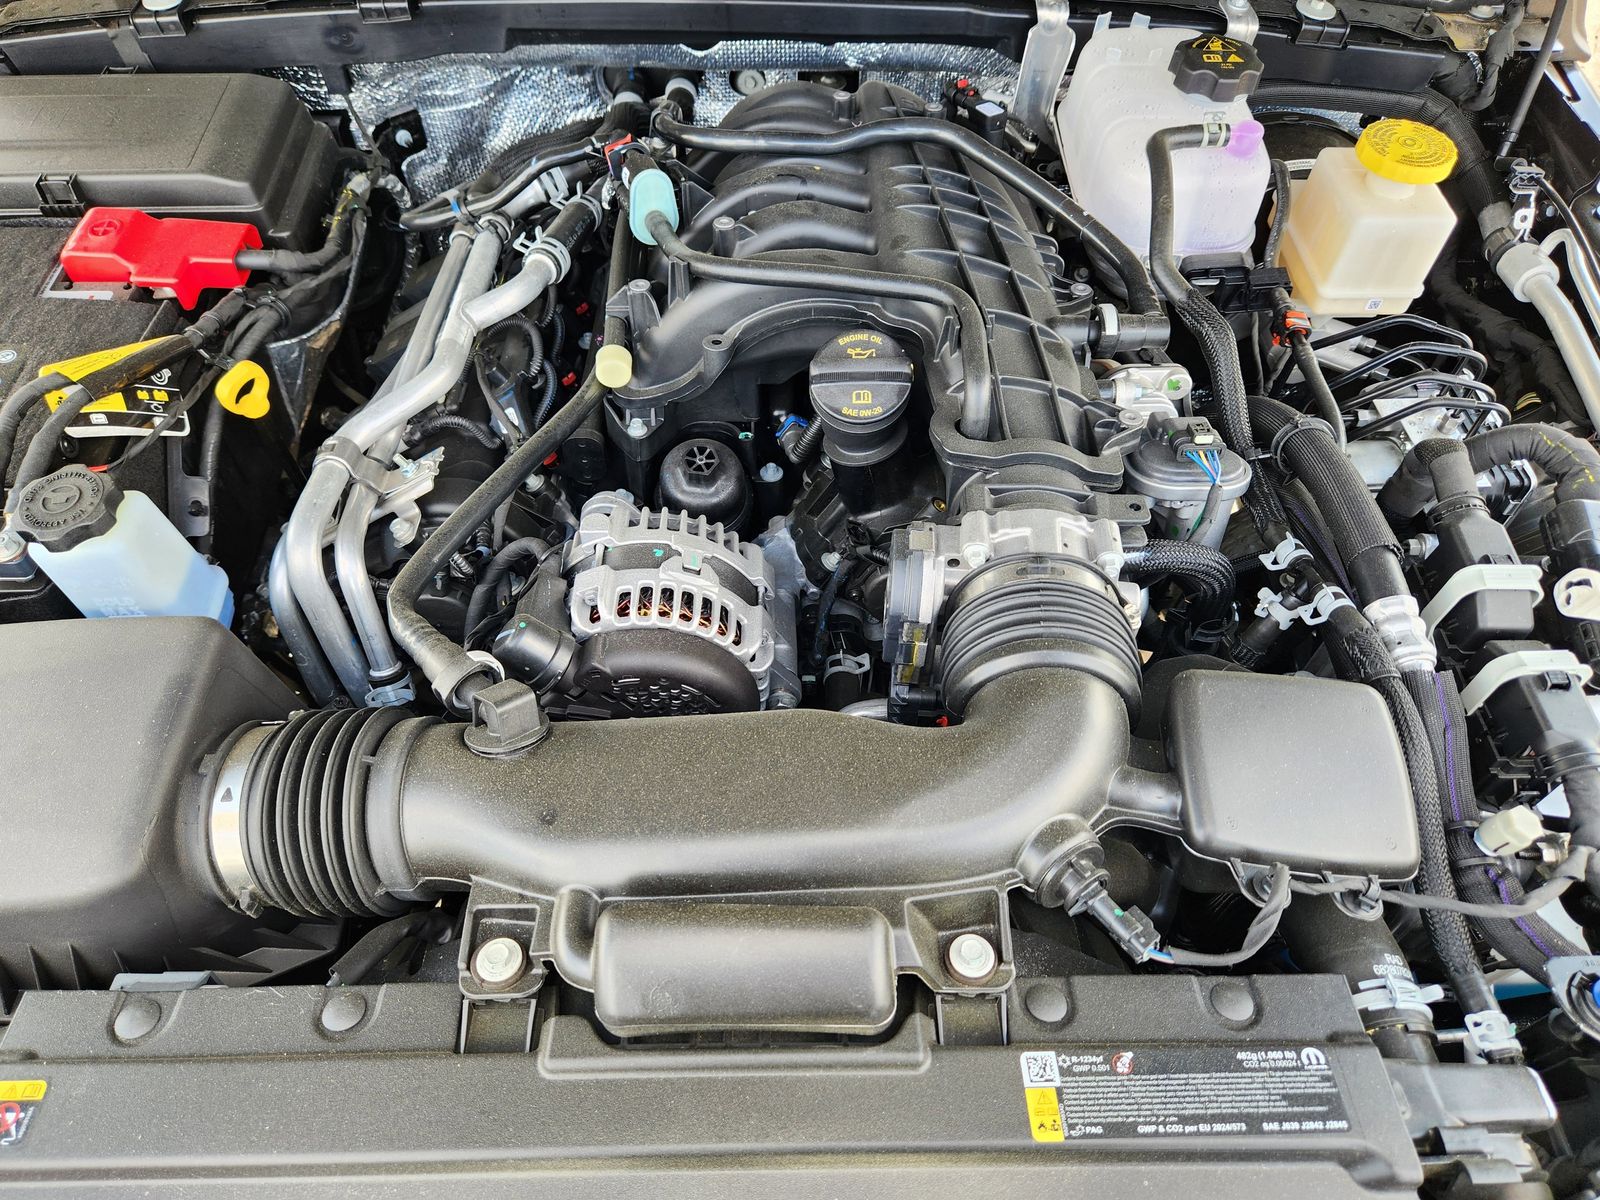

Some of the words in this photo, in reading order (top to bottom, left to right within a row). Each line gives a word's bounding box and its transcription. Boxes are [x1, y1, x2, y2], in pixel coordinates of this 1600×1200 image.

[839, 334, 869, 345] ENGINE
[870, 335, 882, 345] OIL
[842, 406, 859, 417] SAE
[859, 406, 883, 416] 0W-20
[1073, 1064, 1090, 1073] GWP
[1085, 1125, 1104, 1135] PAG
[1137, 1125, 1157, 1134] GWP
[1166, 1124, 1184, 1133] CO2
[1185, 1124, 1198, 1134] per
[1200, 1123, 1211, 1132] EU
[1262, 1122, 1280, 1131] SAE
